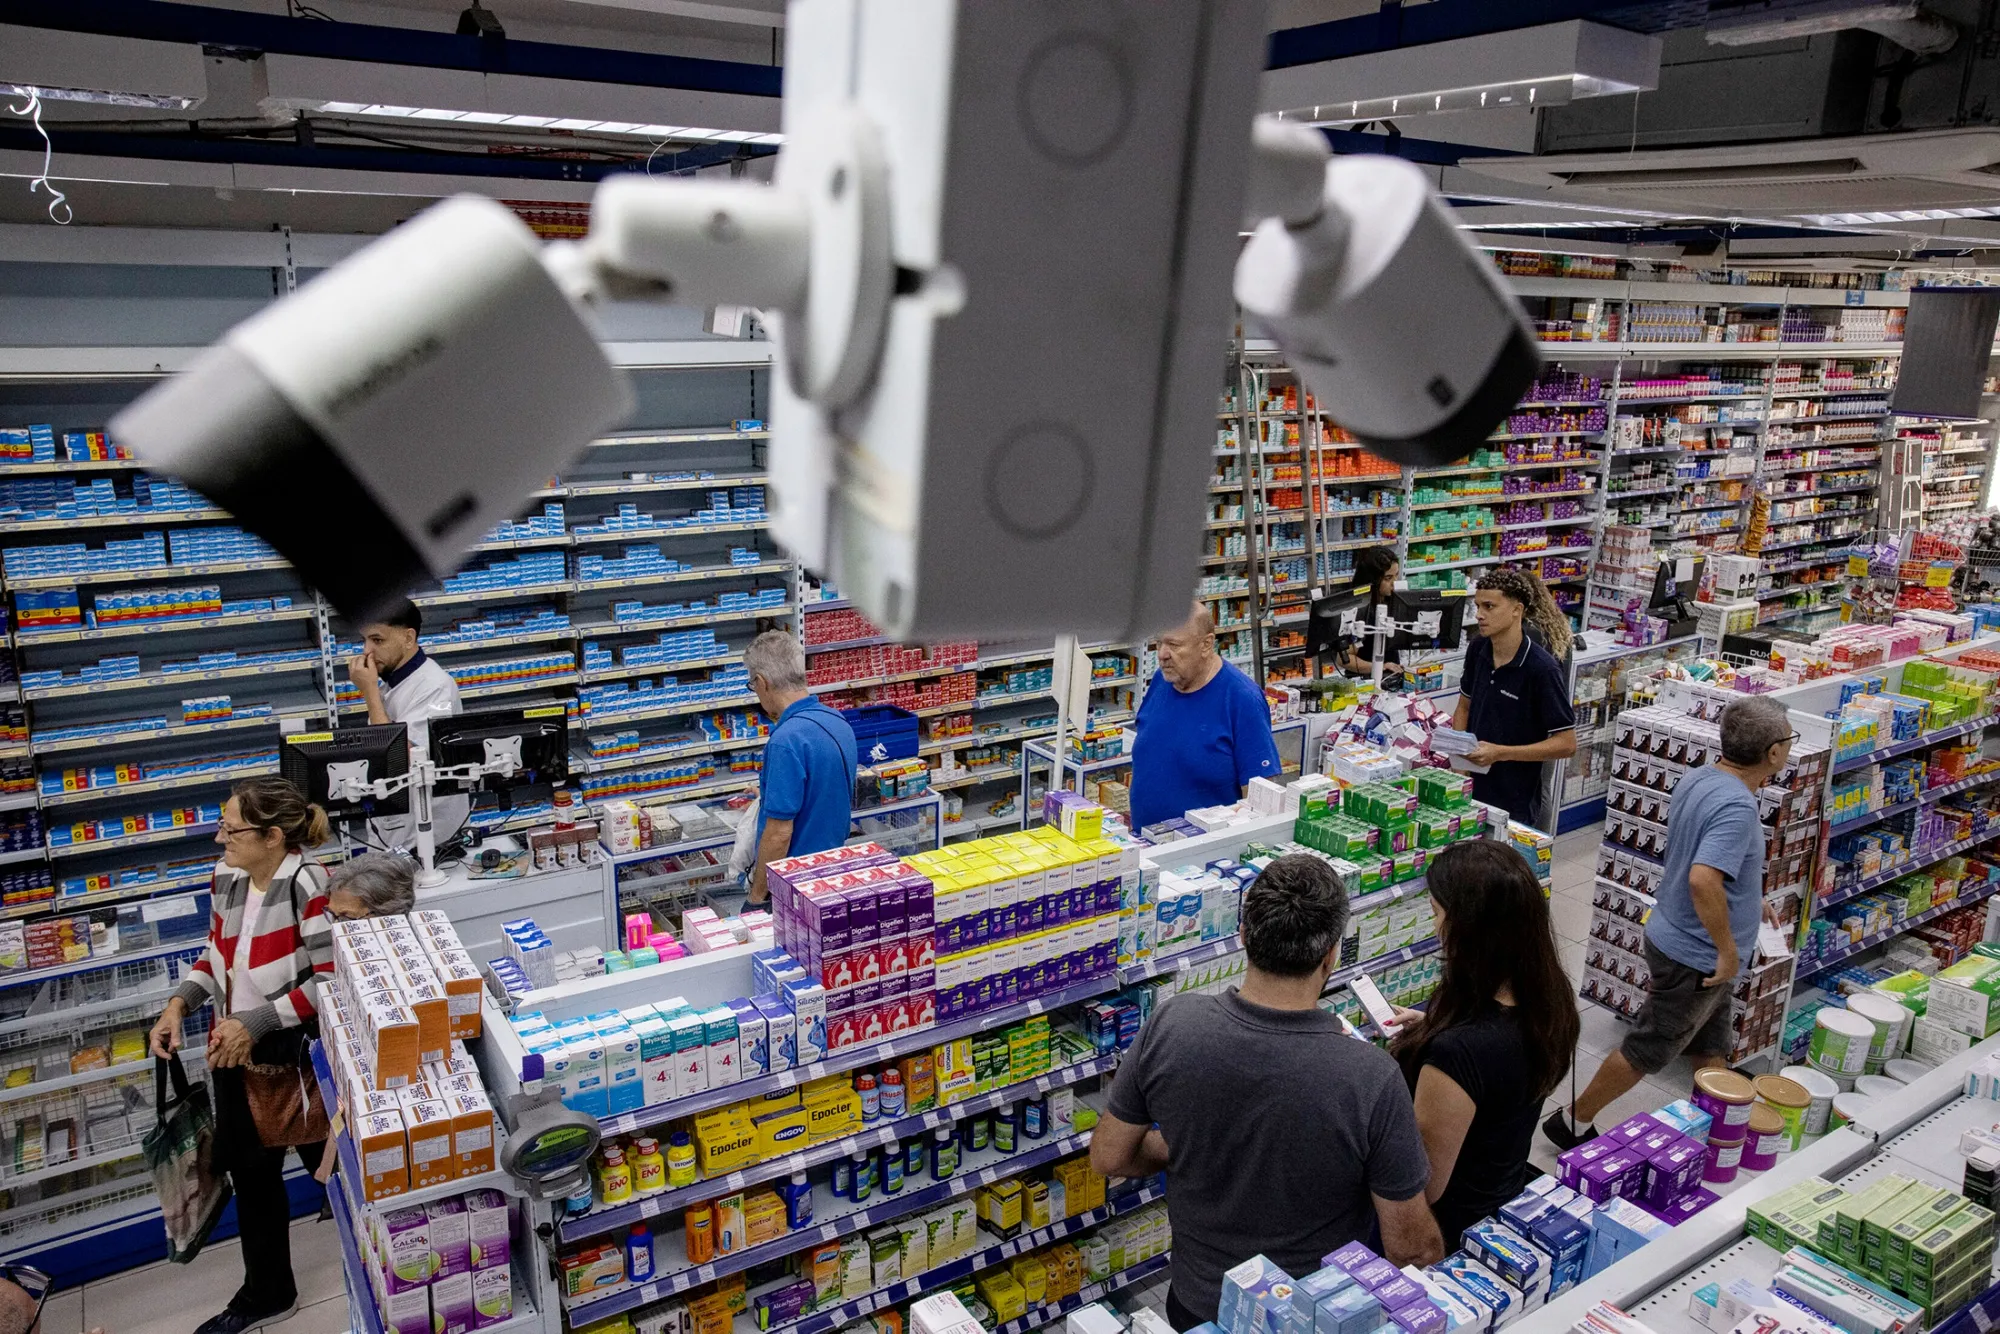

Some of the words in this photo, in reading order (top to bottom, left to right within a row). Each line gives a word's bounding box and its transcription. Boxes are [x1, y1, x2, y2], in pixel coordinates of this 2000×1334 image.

[880, 918, 904, 929] Digeflex
[909, 912, 933, 923] Digeflex
[851, 924, 876, 935] Digeflex
[823, 932, 848, 943] Digeflex
[882, 978, 906, 989] Digeflex
[910, 972, 934, 983] Digeflex
[854, 985, 879, 996] Digeflex
[826, 992, 851, 1003] Digeflex
[676, 1024, 702, 1036] Mylanta
[709, 1018, 735, 1030] Mylanta
[644, 1033, 670, 1046] Mylanta
[722, 1055, 731, 1066] 4
[689, 1062, 698, 1074] 4
[657, 1070, 667, 1083] 4
[811, 1101, 852, 1122] Epocler
[775, 1126, 804, 1140] ENGOV
[710, 1135, 754, 1157] Epocler
[641, 1165, 660, 1179] ENO
[609, 1176, 628, 1191] ENO
